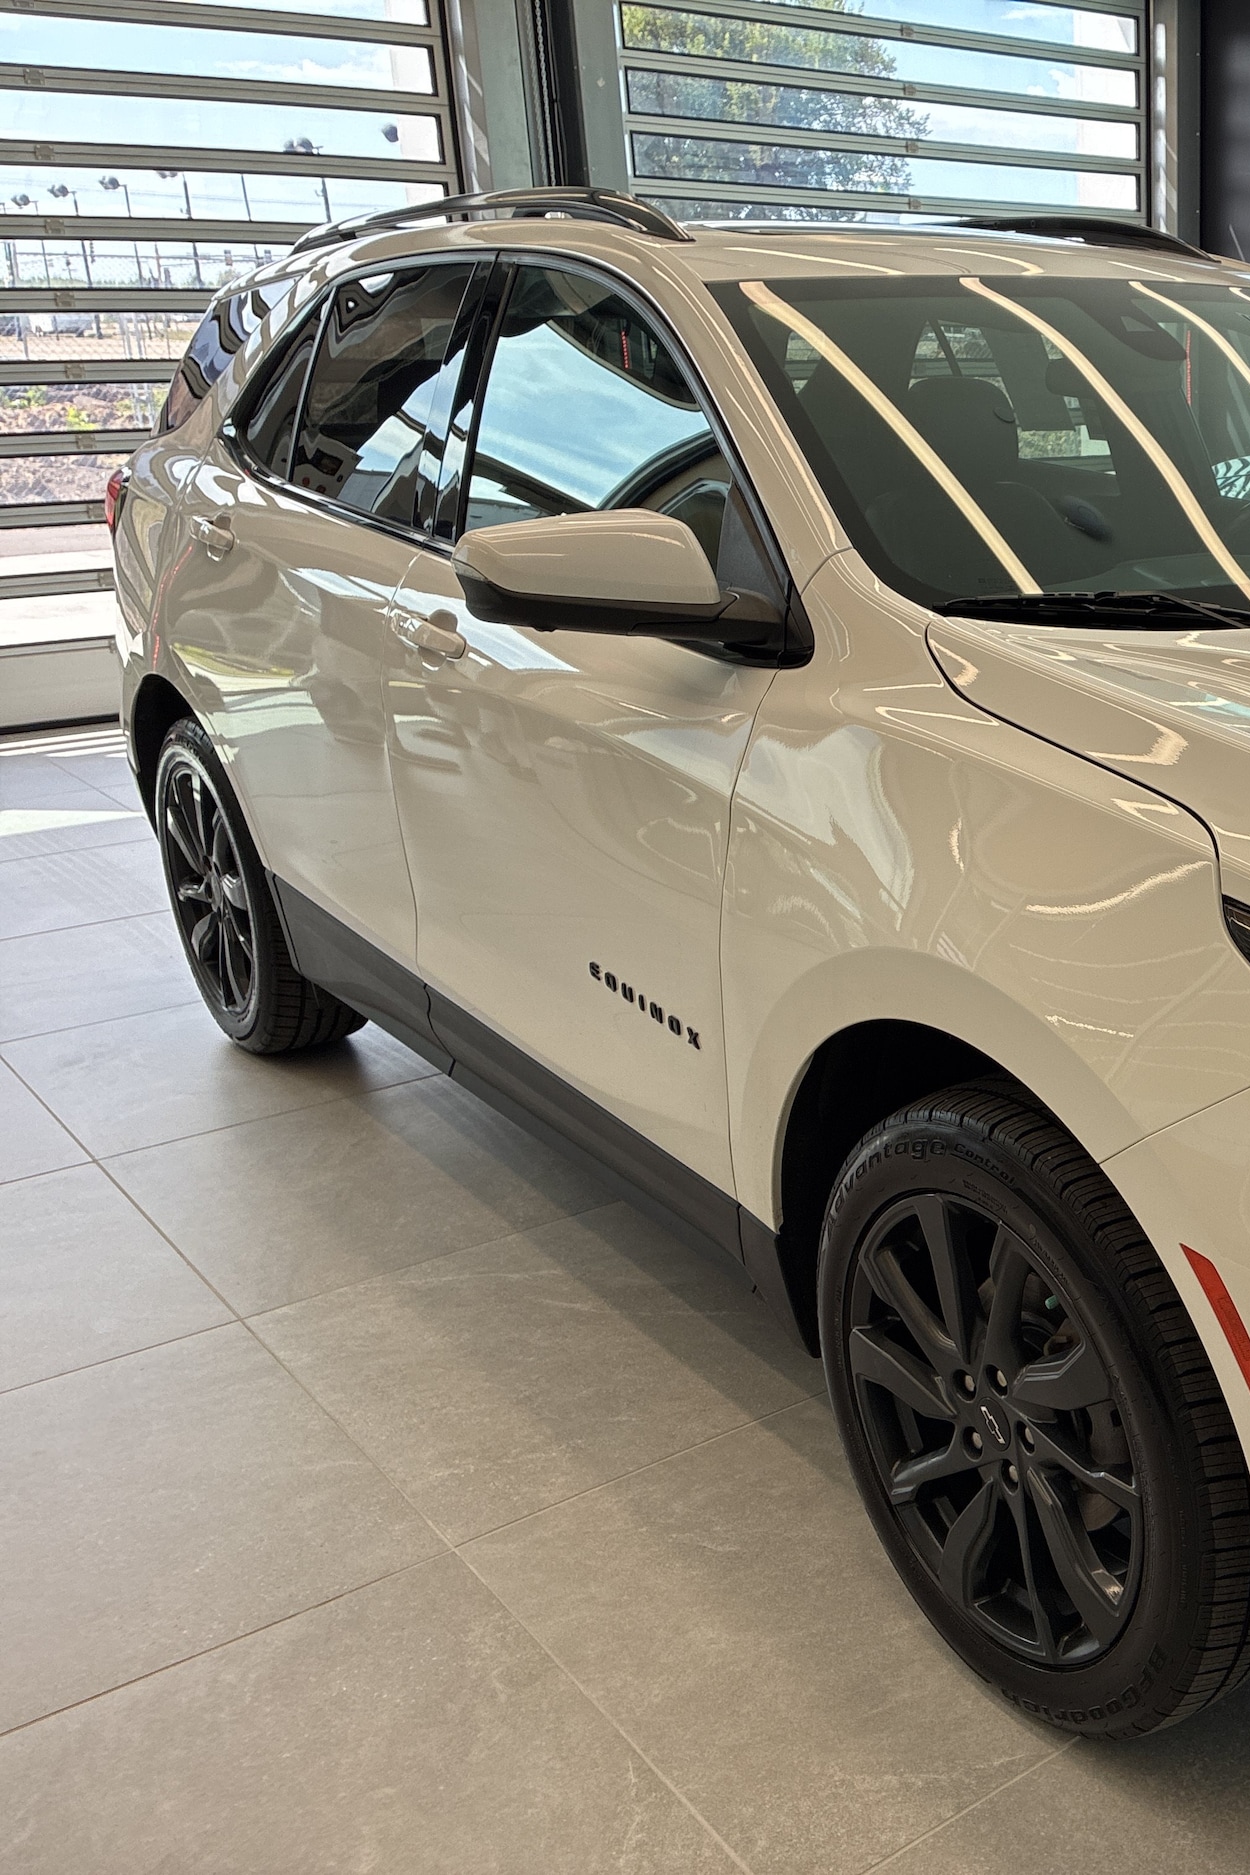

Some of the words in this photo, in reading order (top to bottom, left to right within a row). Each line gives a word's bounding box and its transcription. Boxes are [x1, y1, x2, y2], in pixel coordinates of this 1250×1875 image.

[589, 961, 701, 1050] EQUINOX
[821, 1136, 948, 1246] Advantage
[953, 1142, 1016, 1187] Control
